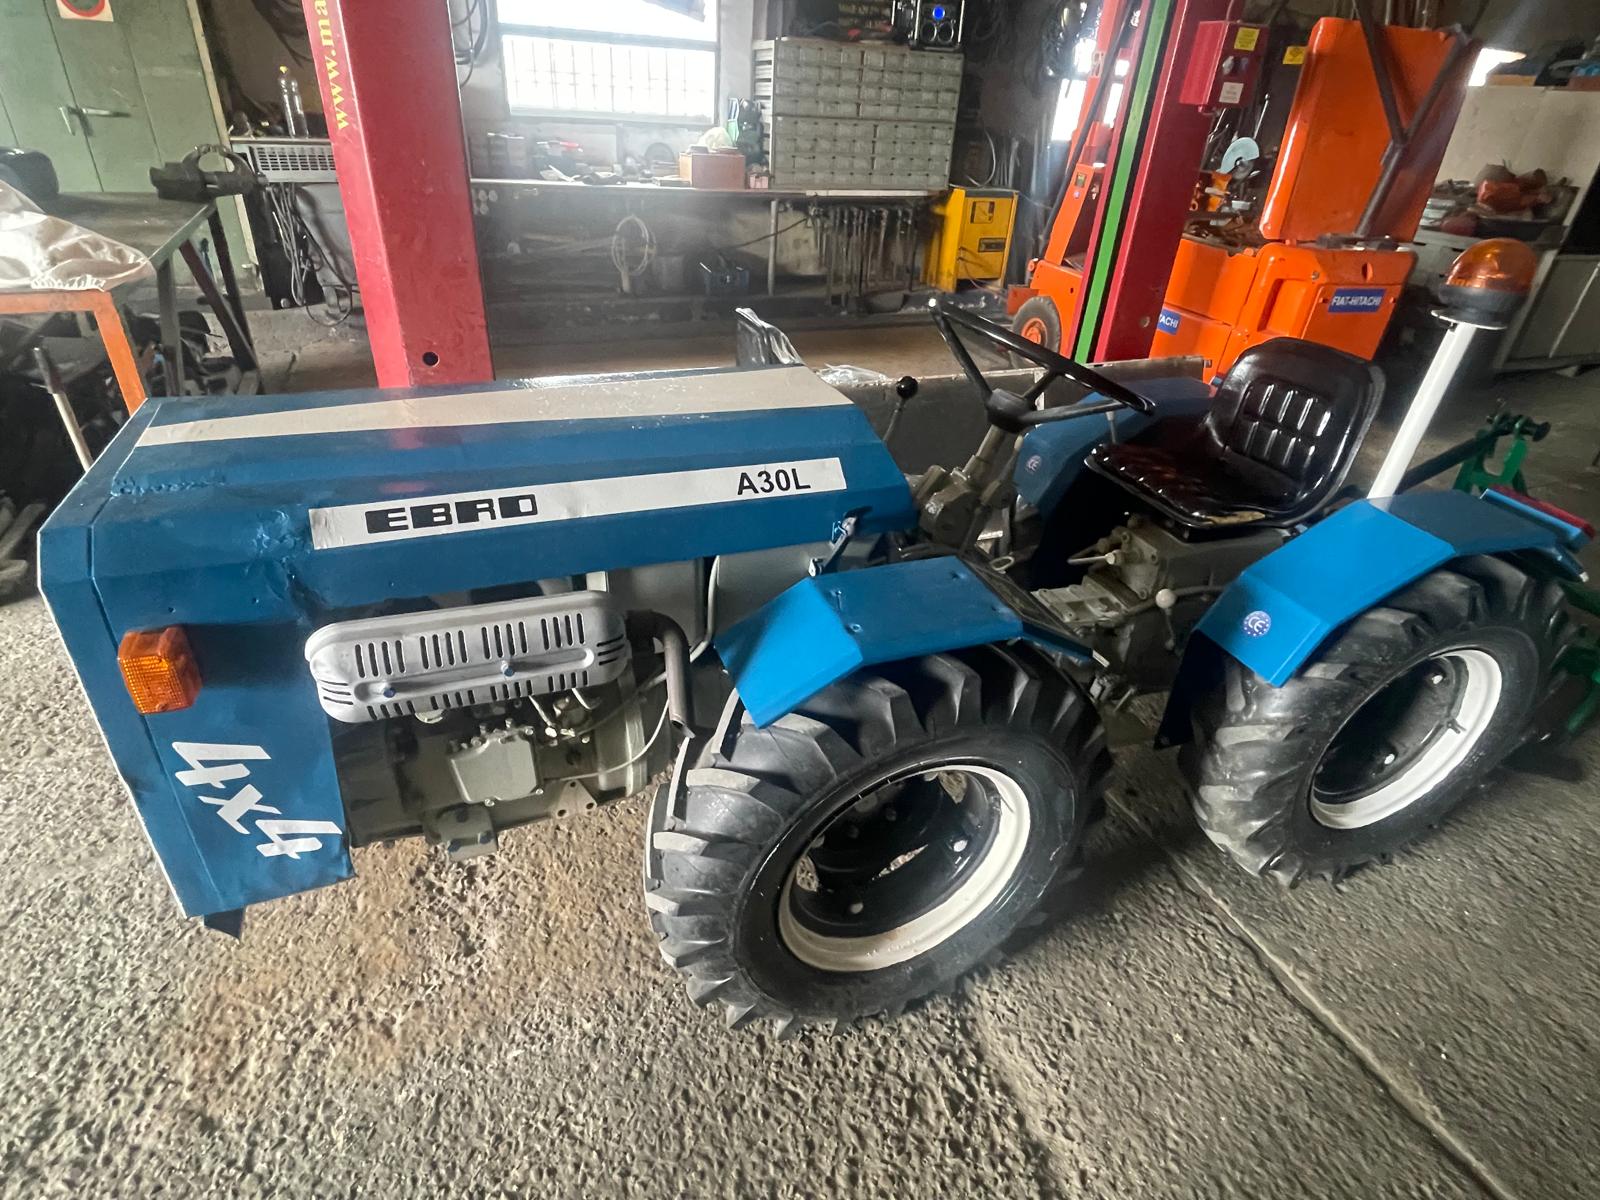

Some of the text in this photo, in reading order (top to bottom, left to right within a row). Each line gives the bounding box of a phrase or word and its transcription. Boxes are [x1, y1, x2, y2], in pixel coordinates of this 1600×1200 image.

[1331, 295, 1383, 306] FIAT-HITACHI
[365, 468, 811, 534] EBRO A30L
[172, 741, 343, 859] 4x4
